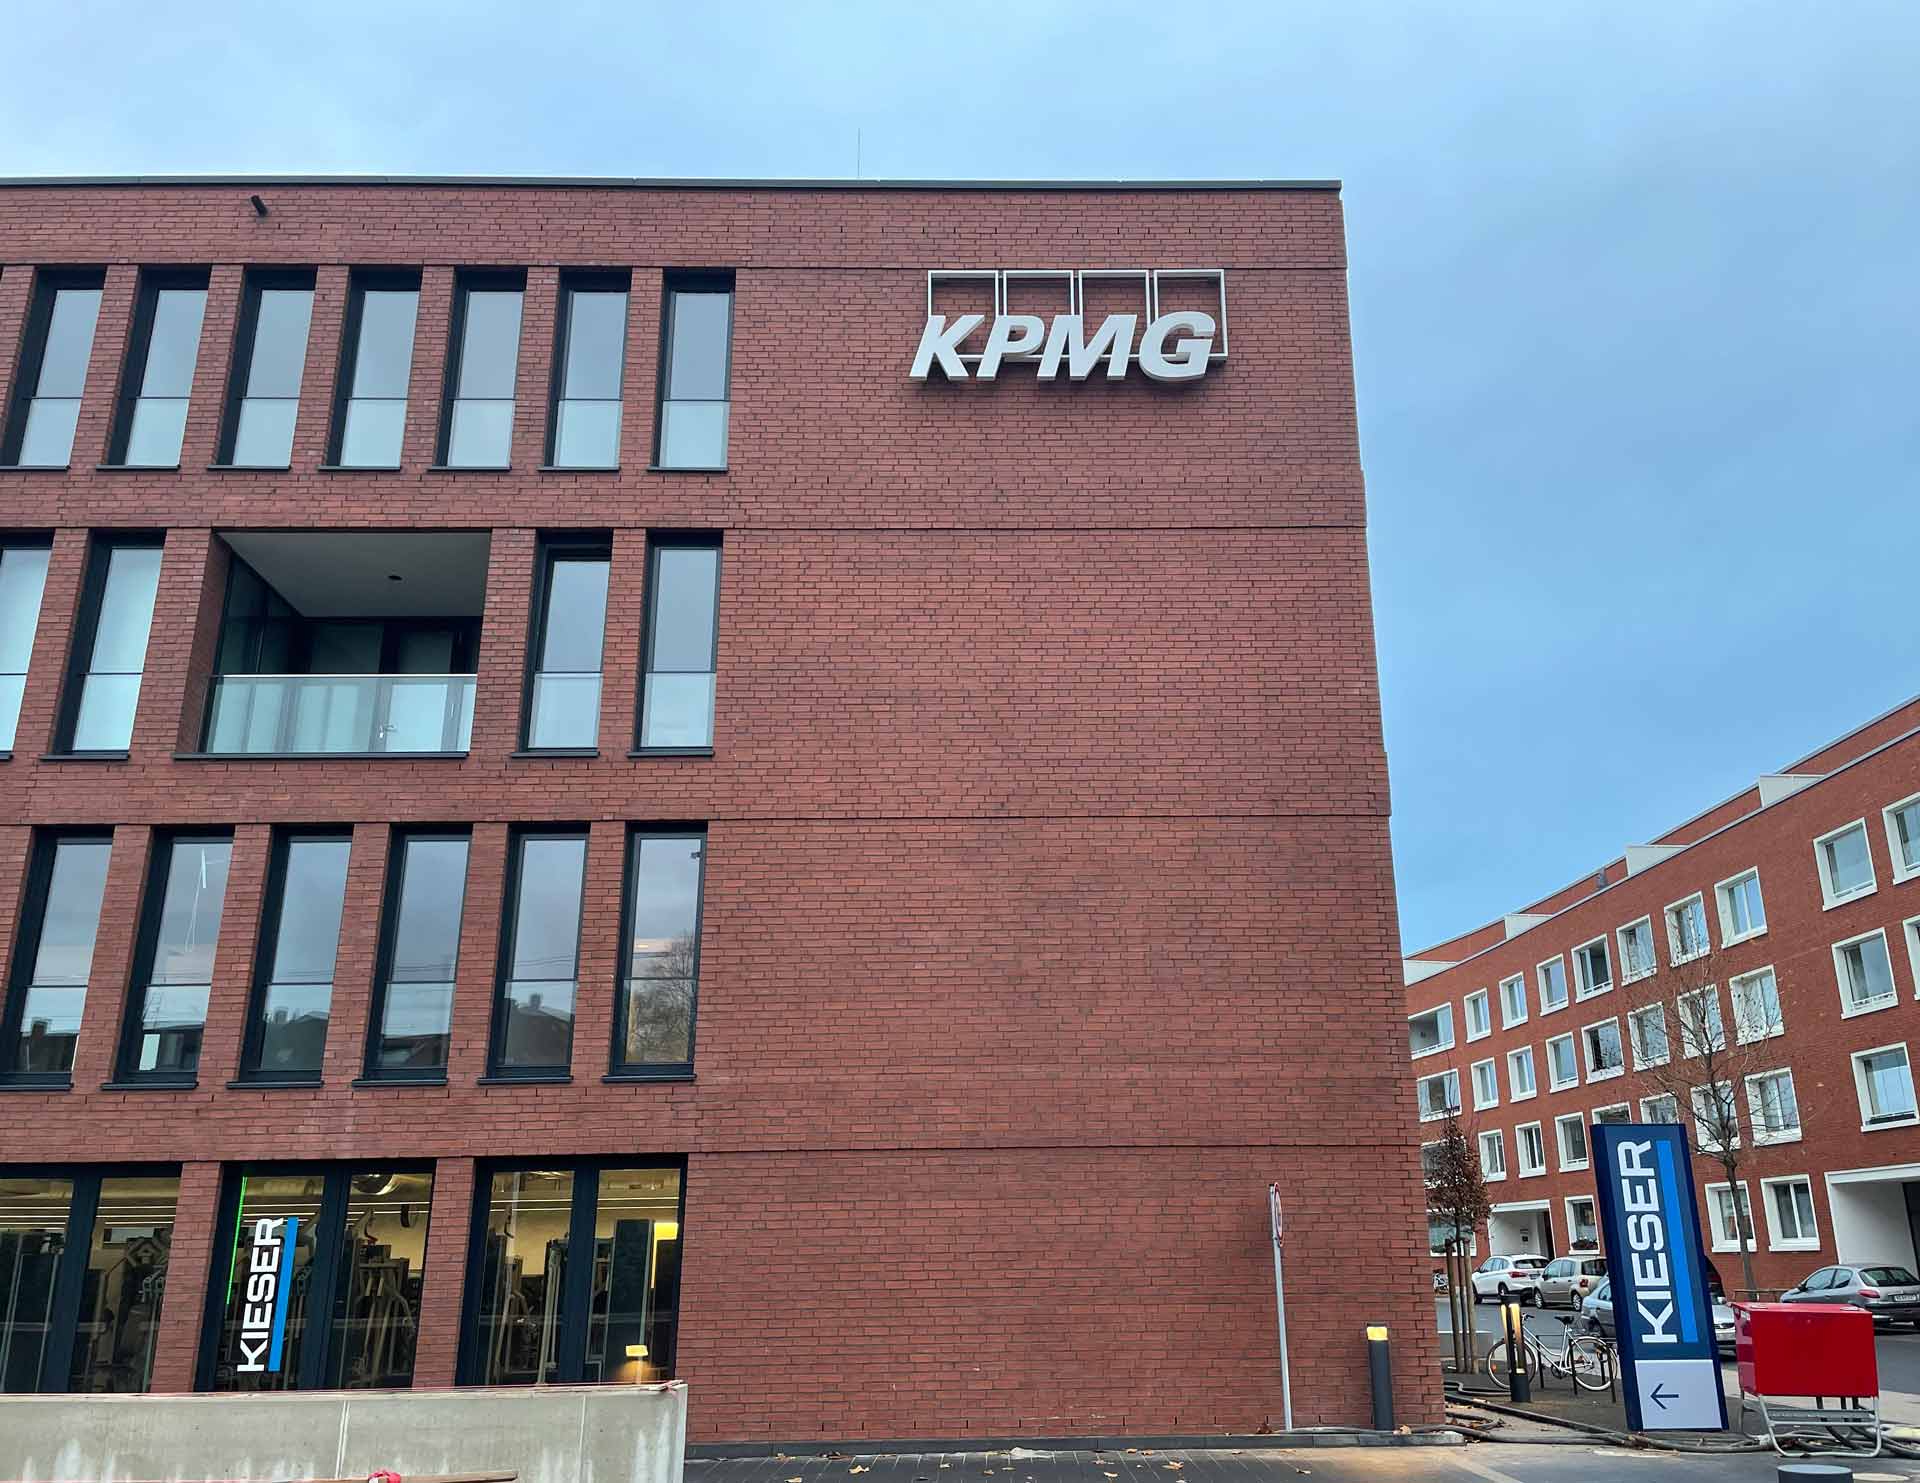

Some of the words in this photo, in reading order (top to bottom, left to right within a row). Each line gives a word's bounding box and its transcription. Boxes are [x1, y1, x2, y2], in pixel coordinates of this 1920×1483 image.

[909, 311, 1217, 381] KPMG
[236, 1217, 284, 1372] KIESER
[1616, 1139, 1678, 1344] KIESER
